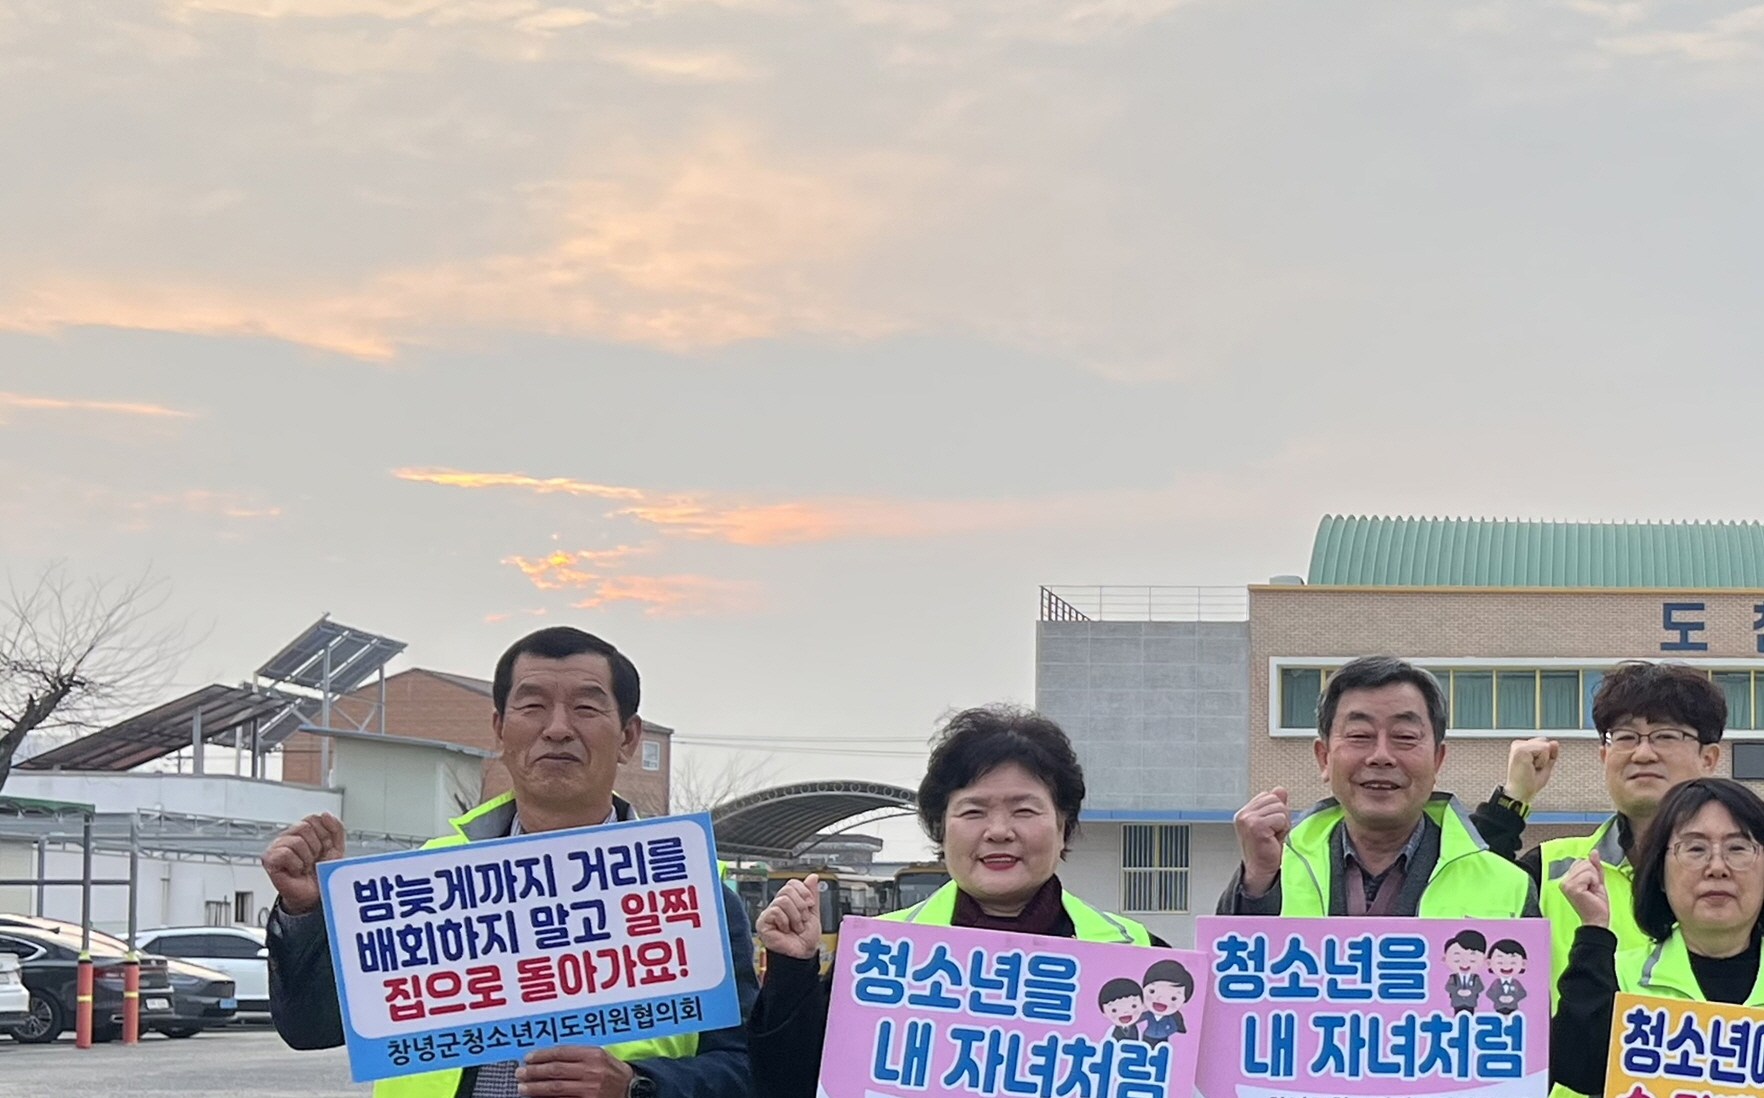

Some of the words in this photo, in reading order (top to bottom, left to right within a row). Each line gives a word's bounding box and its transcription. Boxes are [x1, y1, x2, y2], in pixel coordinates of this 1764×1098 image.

[353, 853, 558, 924] 밤늦게까지
[567, 836, 689, 892] 거리를
[356, 909, 519, 973] 배회하지
[531, 899, 612, 950] 말고
[621, 884, 702, 938] 일찍
[1216, 935, 1427, 1000] 청소년을
[382, 964, 507, 1023] 집으로
[516, 937, 689, 1003] 돌아가요!
[854, 936, 1077, 1022] 청소년을
[387, 996, 703, 1067] 창녕군청소년지도위원협의회
[874, 1020, 931, 1087] 내
[1244, 1013, 1295, 1077] 내
[1311, 1013, 1523, 1078] 자녀처럼
